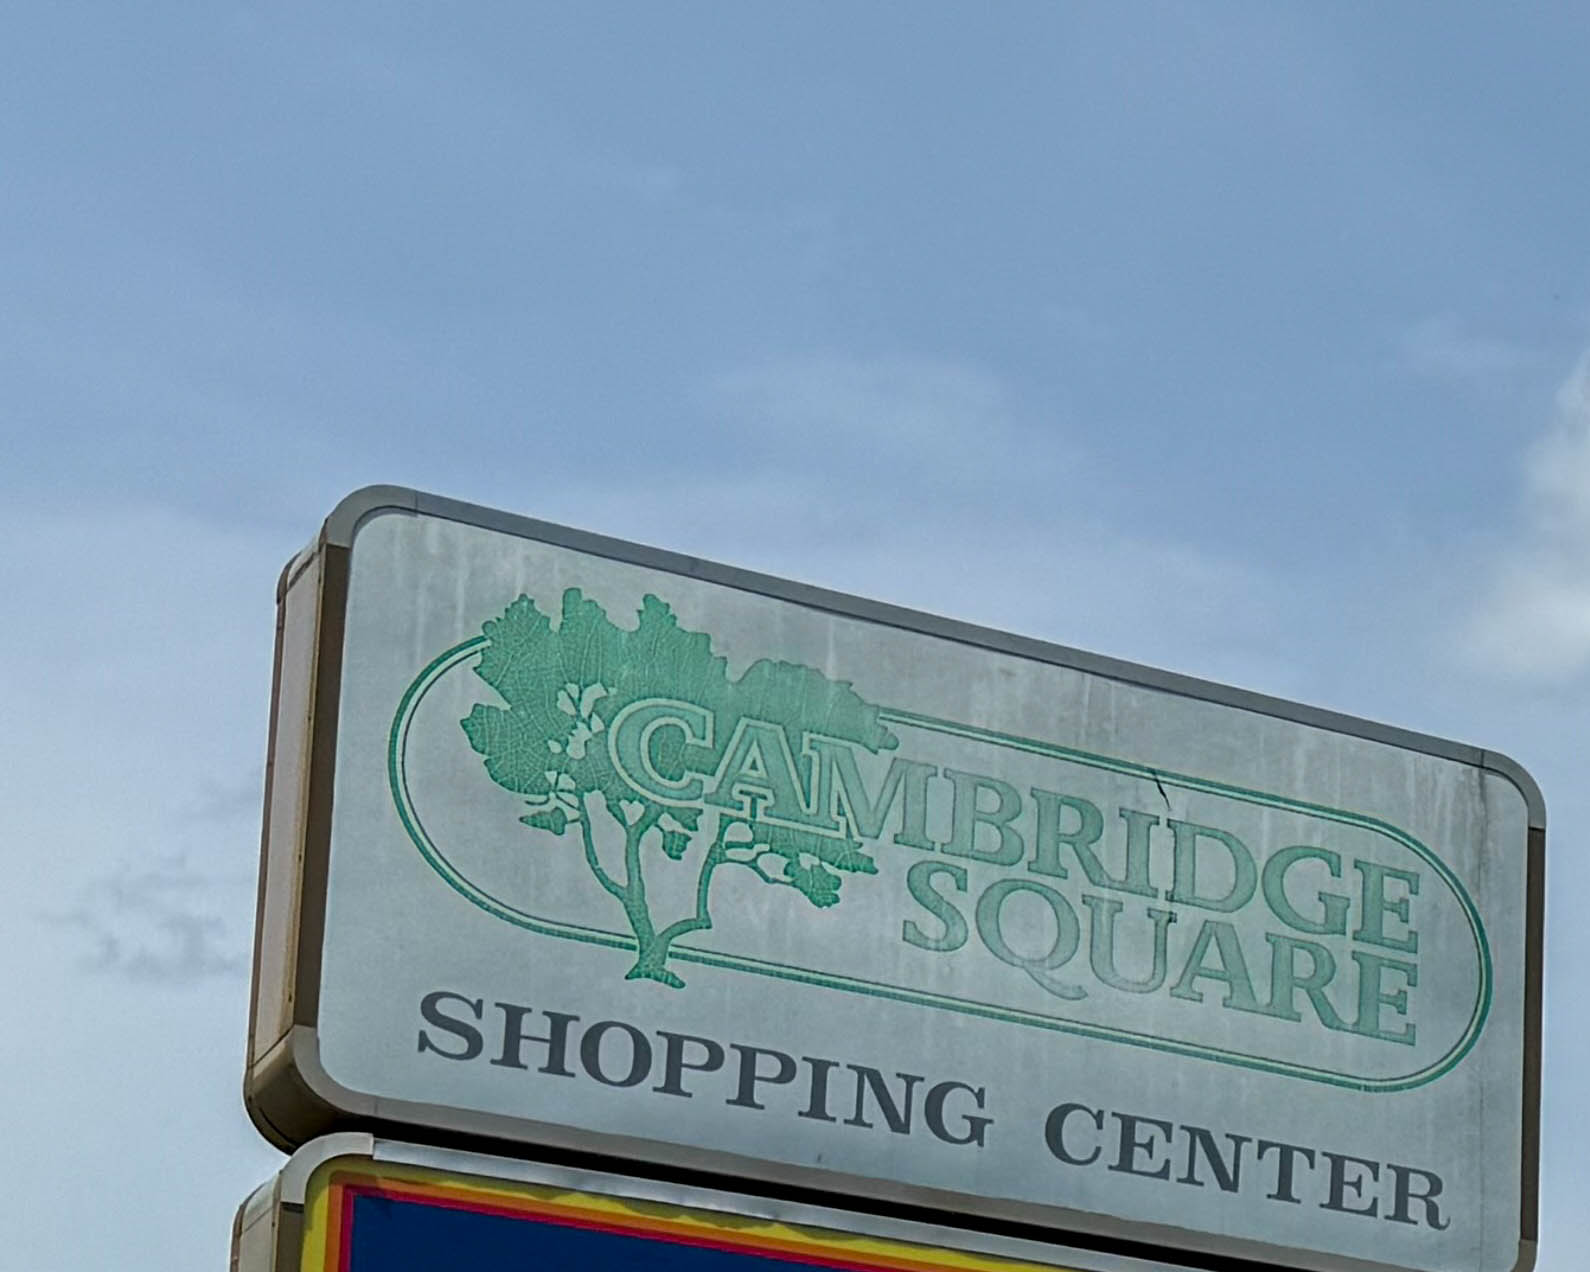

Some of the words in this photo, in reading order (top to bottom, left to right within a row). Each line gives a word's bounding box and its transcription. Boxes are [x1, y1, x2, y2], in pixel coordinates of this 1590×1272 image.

[606, 697, 1420, 954] CAMBRIDGE
[902, 860, 1418, 1046] SQUARE
[417, 991, 994, 1148] SHOPPING
[1043, 1101, 1450, 1231] CENTER
